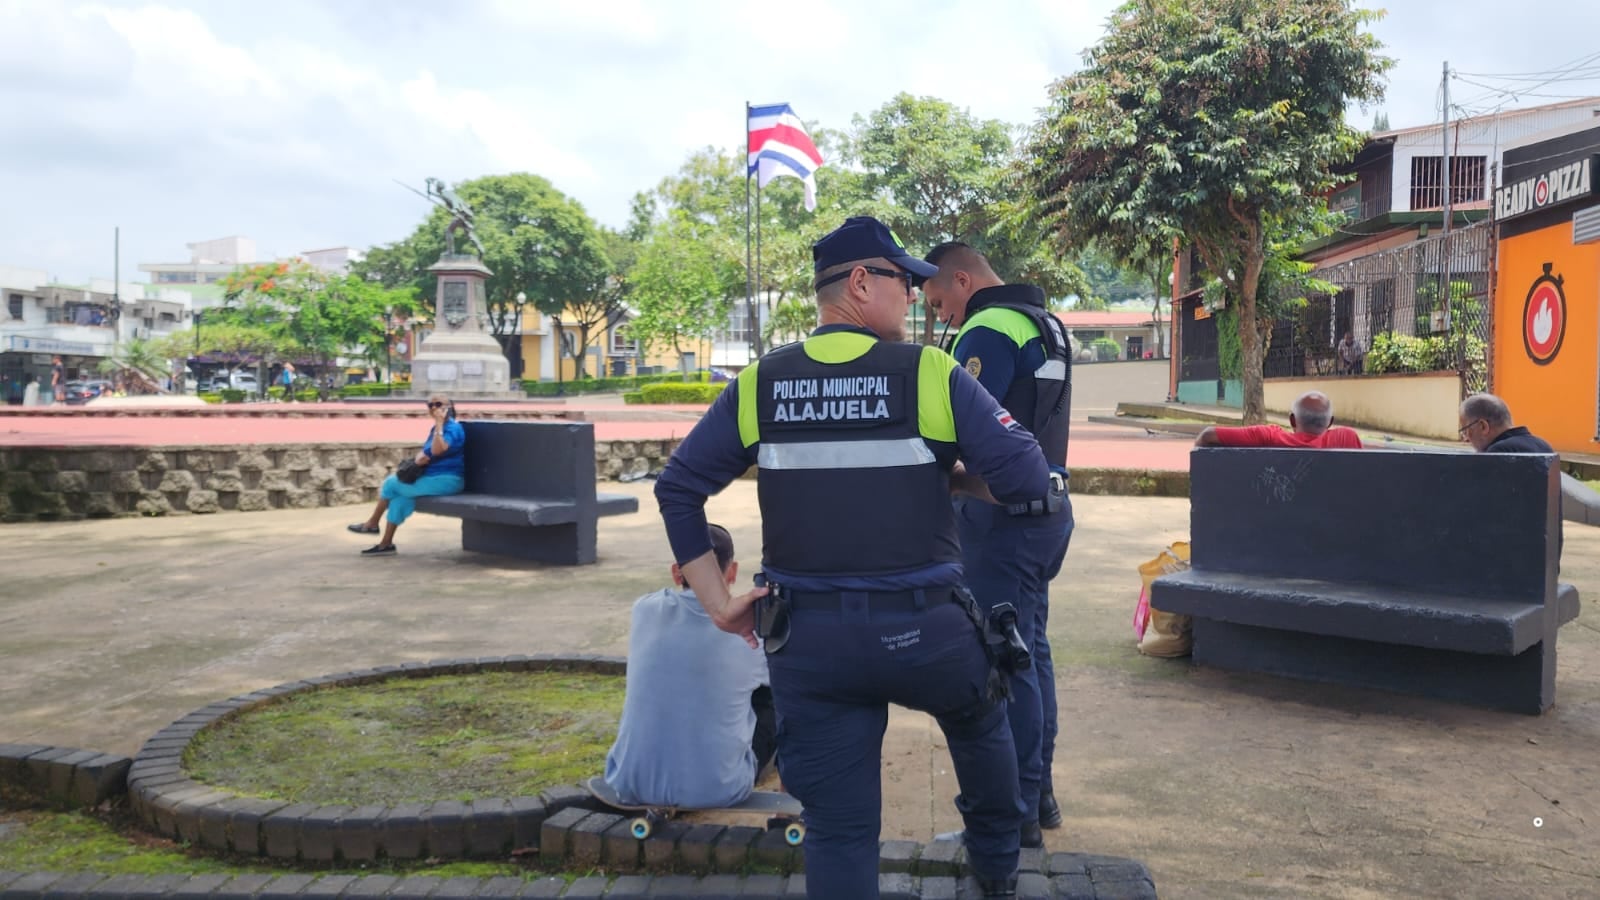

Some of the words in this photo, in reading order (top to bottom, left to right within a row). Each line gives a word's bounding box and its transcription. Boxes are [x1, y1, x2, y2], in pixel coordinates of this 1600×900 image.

[1495, 178, 1536, 221] READY
[1548, 158, 1591, 204] PIZZA
[773, 379, 818, 400] POLICIA
[822, 376, 890, 397] MUNICIPAL
[774, 399, 890, 422] ALAJUELA
